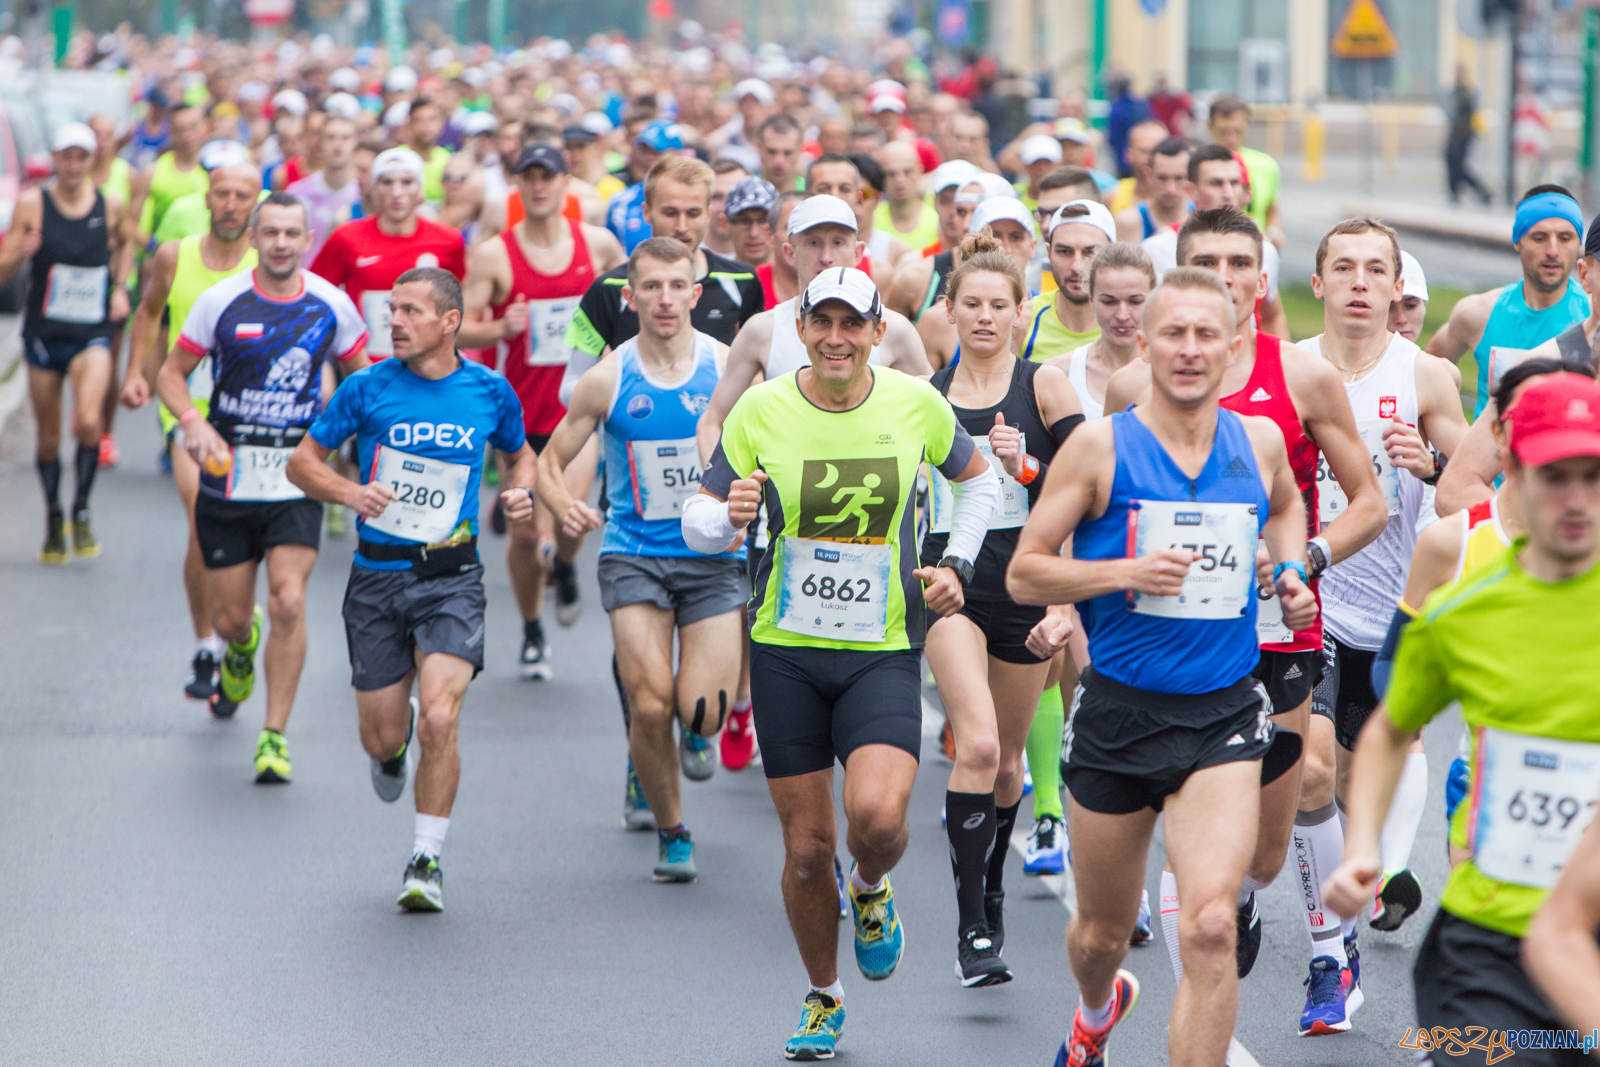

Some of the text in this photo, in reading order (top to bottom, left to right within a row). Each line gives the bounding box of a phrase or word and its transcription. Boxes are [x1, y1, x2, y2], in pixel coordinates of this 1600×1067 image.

[389, 422, 475, 450] OPEX
[251, 451, 291, 469] 139
[1316, 455, 1382, 482] 36
[663, 466, 702, 487] 514
[1223, 469, 1254, 479] adidas
[391, 480, 446, 509] 1280
[816, 551, 838, 560] 18.PKO
[1169, 544, 1239, 572] 754
[801, 573, 871, 602] 6862
[1183, 574, 1222, 584] ebastian
[820, 601, 849, 611] Łukasz
[1509, 789, 1596, 830] 639
